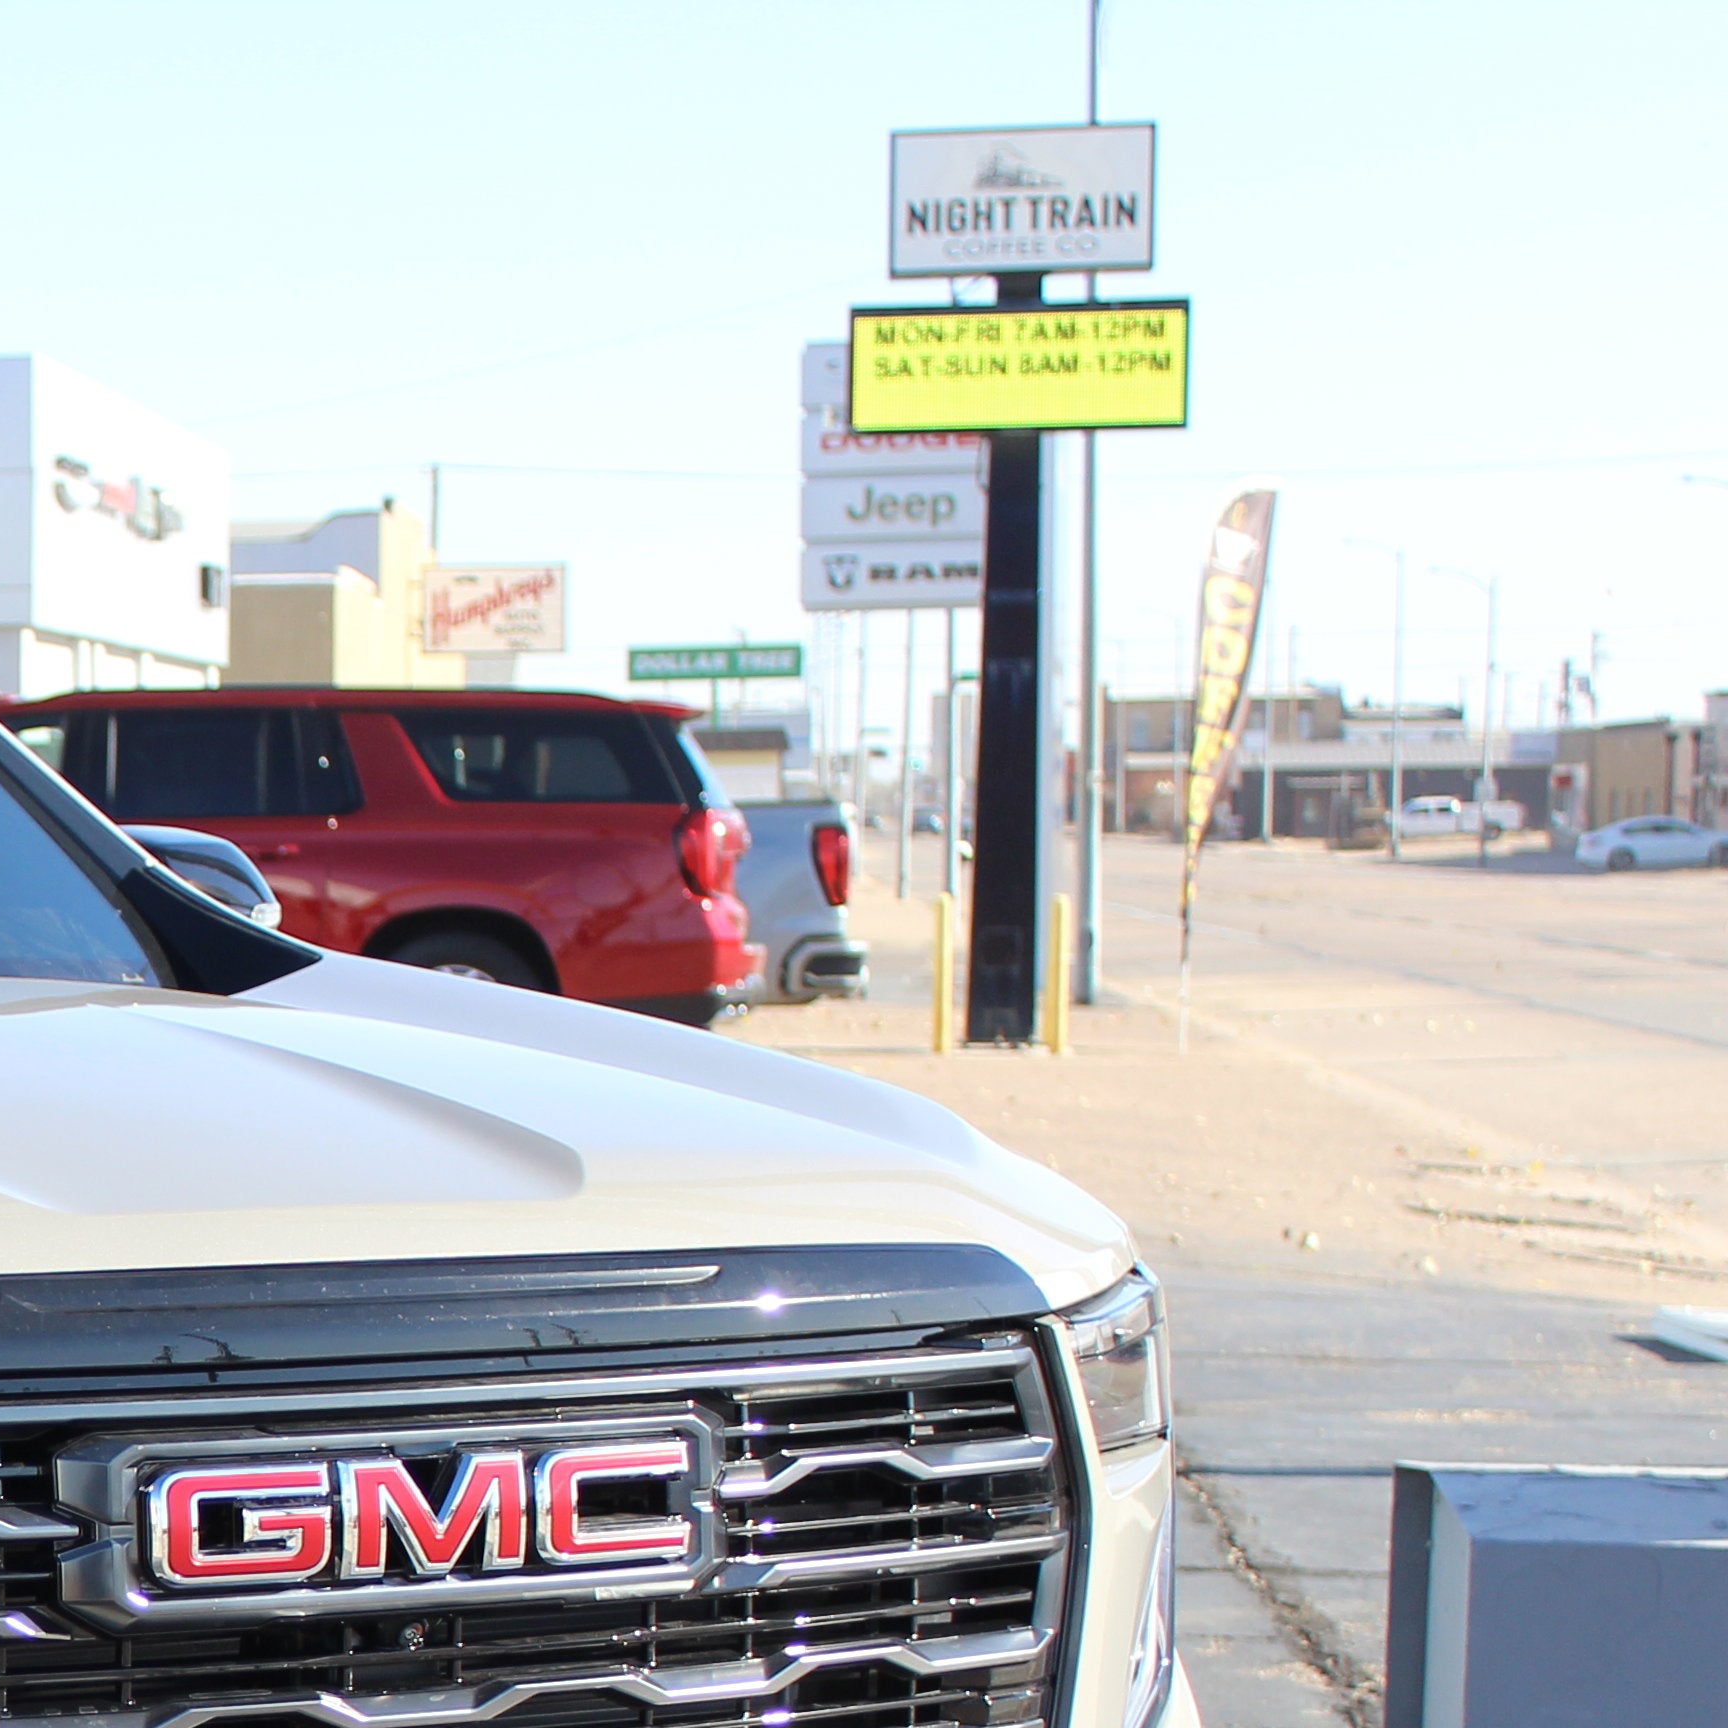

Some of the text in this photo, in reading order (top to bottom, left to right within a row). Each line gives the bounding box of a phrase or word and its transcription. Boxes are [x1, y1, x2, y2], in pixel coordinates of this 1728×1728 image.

[906, 193, 1138, 235] NIGHT TRAIN
[944, 235, 1045, 260] COFFEE
[847, 484, 957, 528] Jeep
[869, 560, 980, 583] RAM
[149, 1437, 691, 1585] GMC
